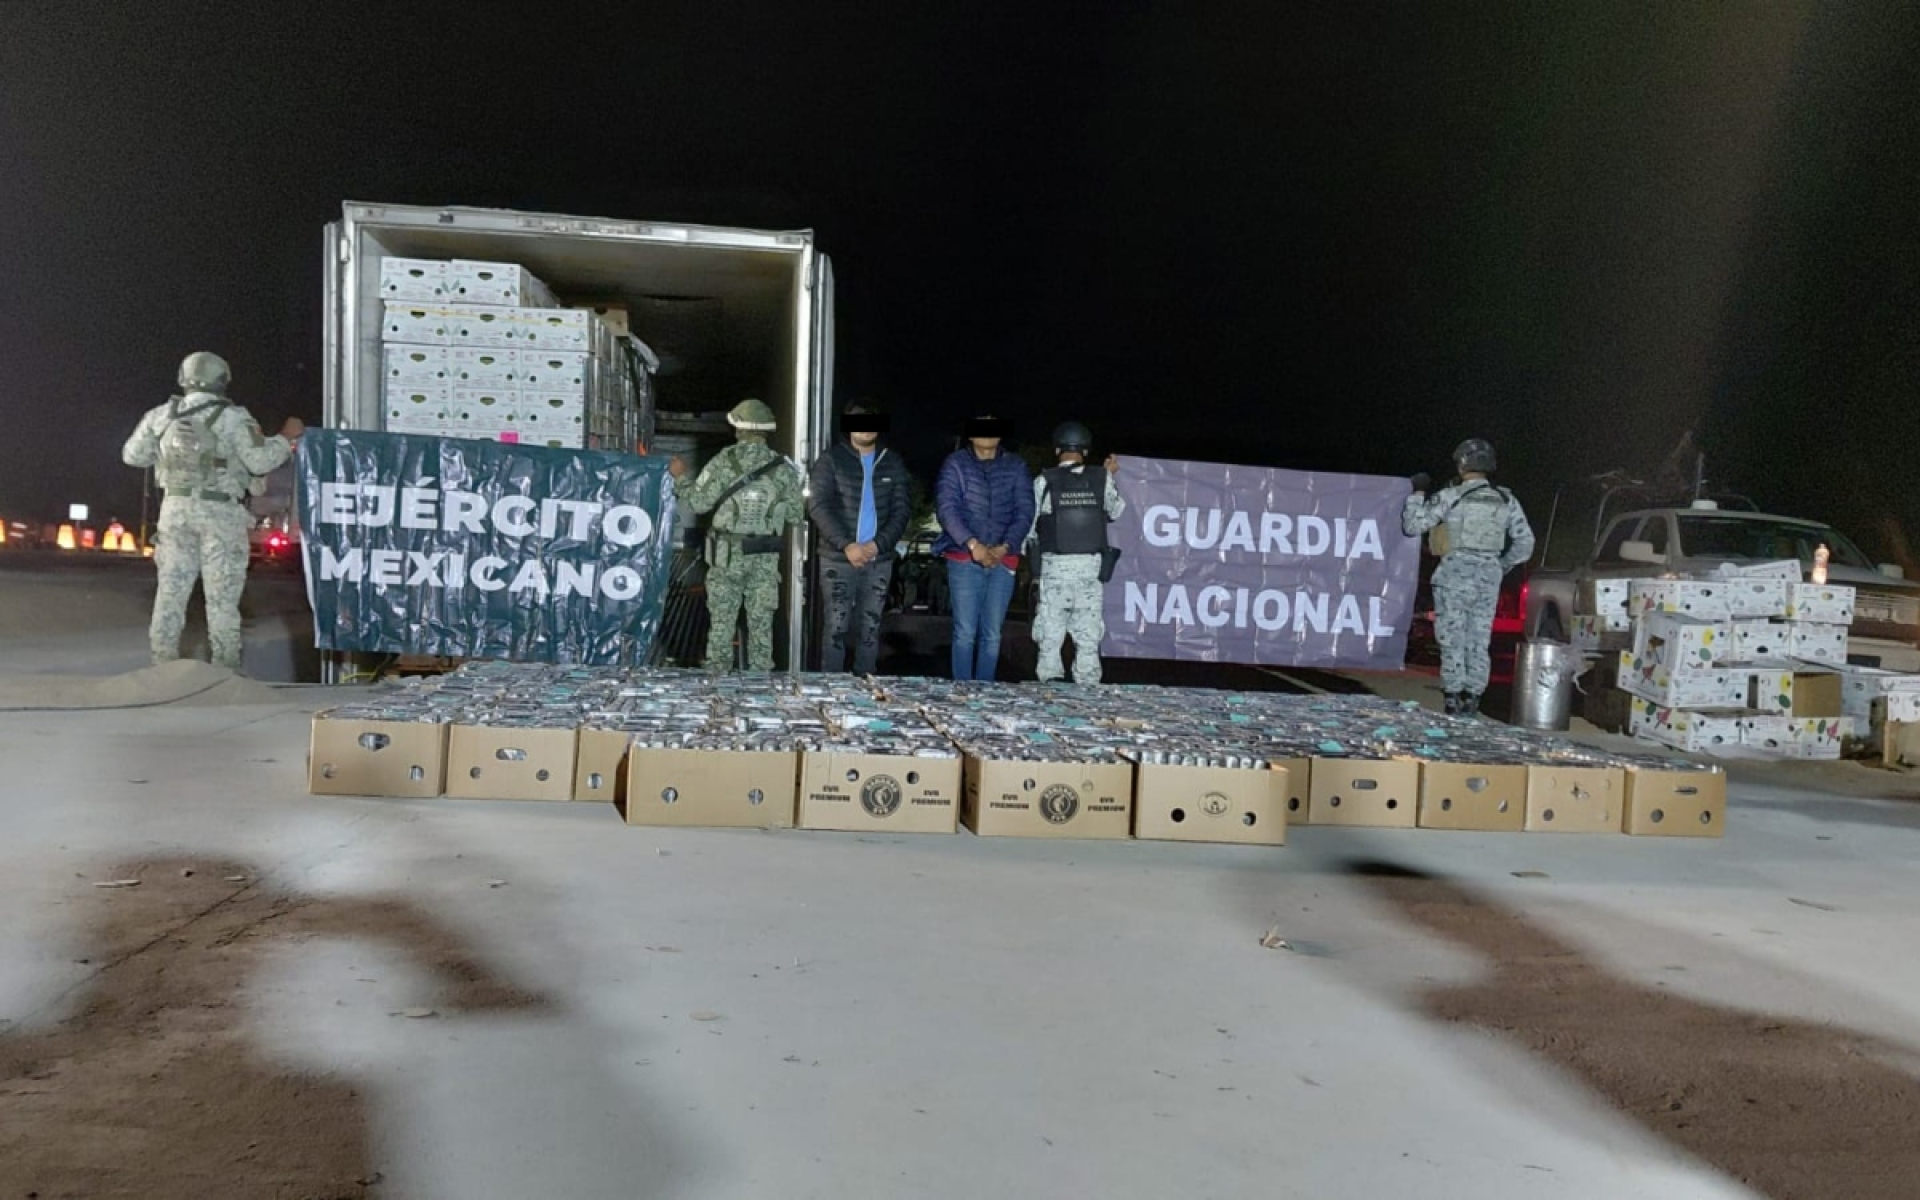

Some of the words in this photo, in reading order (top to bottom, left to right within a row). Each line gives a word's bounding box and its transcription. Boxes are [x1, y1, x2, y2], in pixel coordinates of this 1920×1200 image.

[320, 477, 652, 547] EJÉRCITO
[1143, 504, 1385, 560] GUARDIA
[320, 547, 642, 601] MEXICANO
[1125, 581, 1395, 637] NACIONAL
